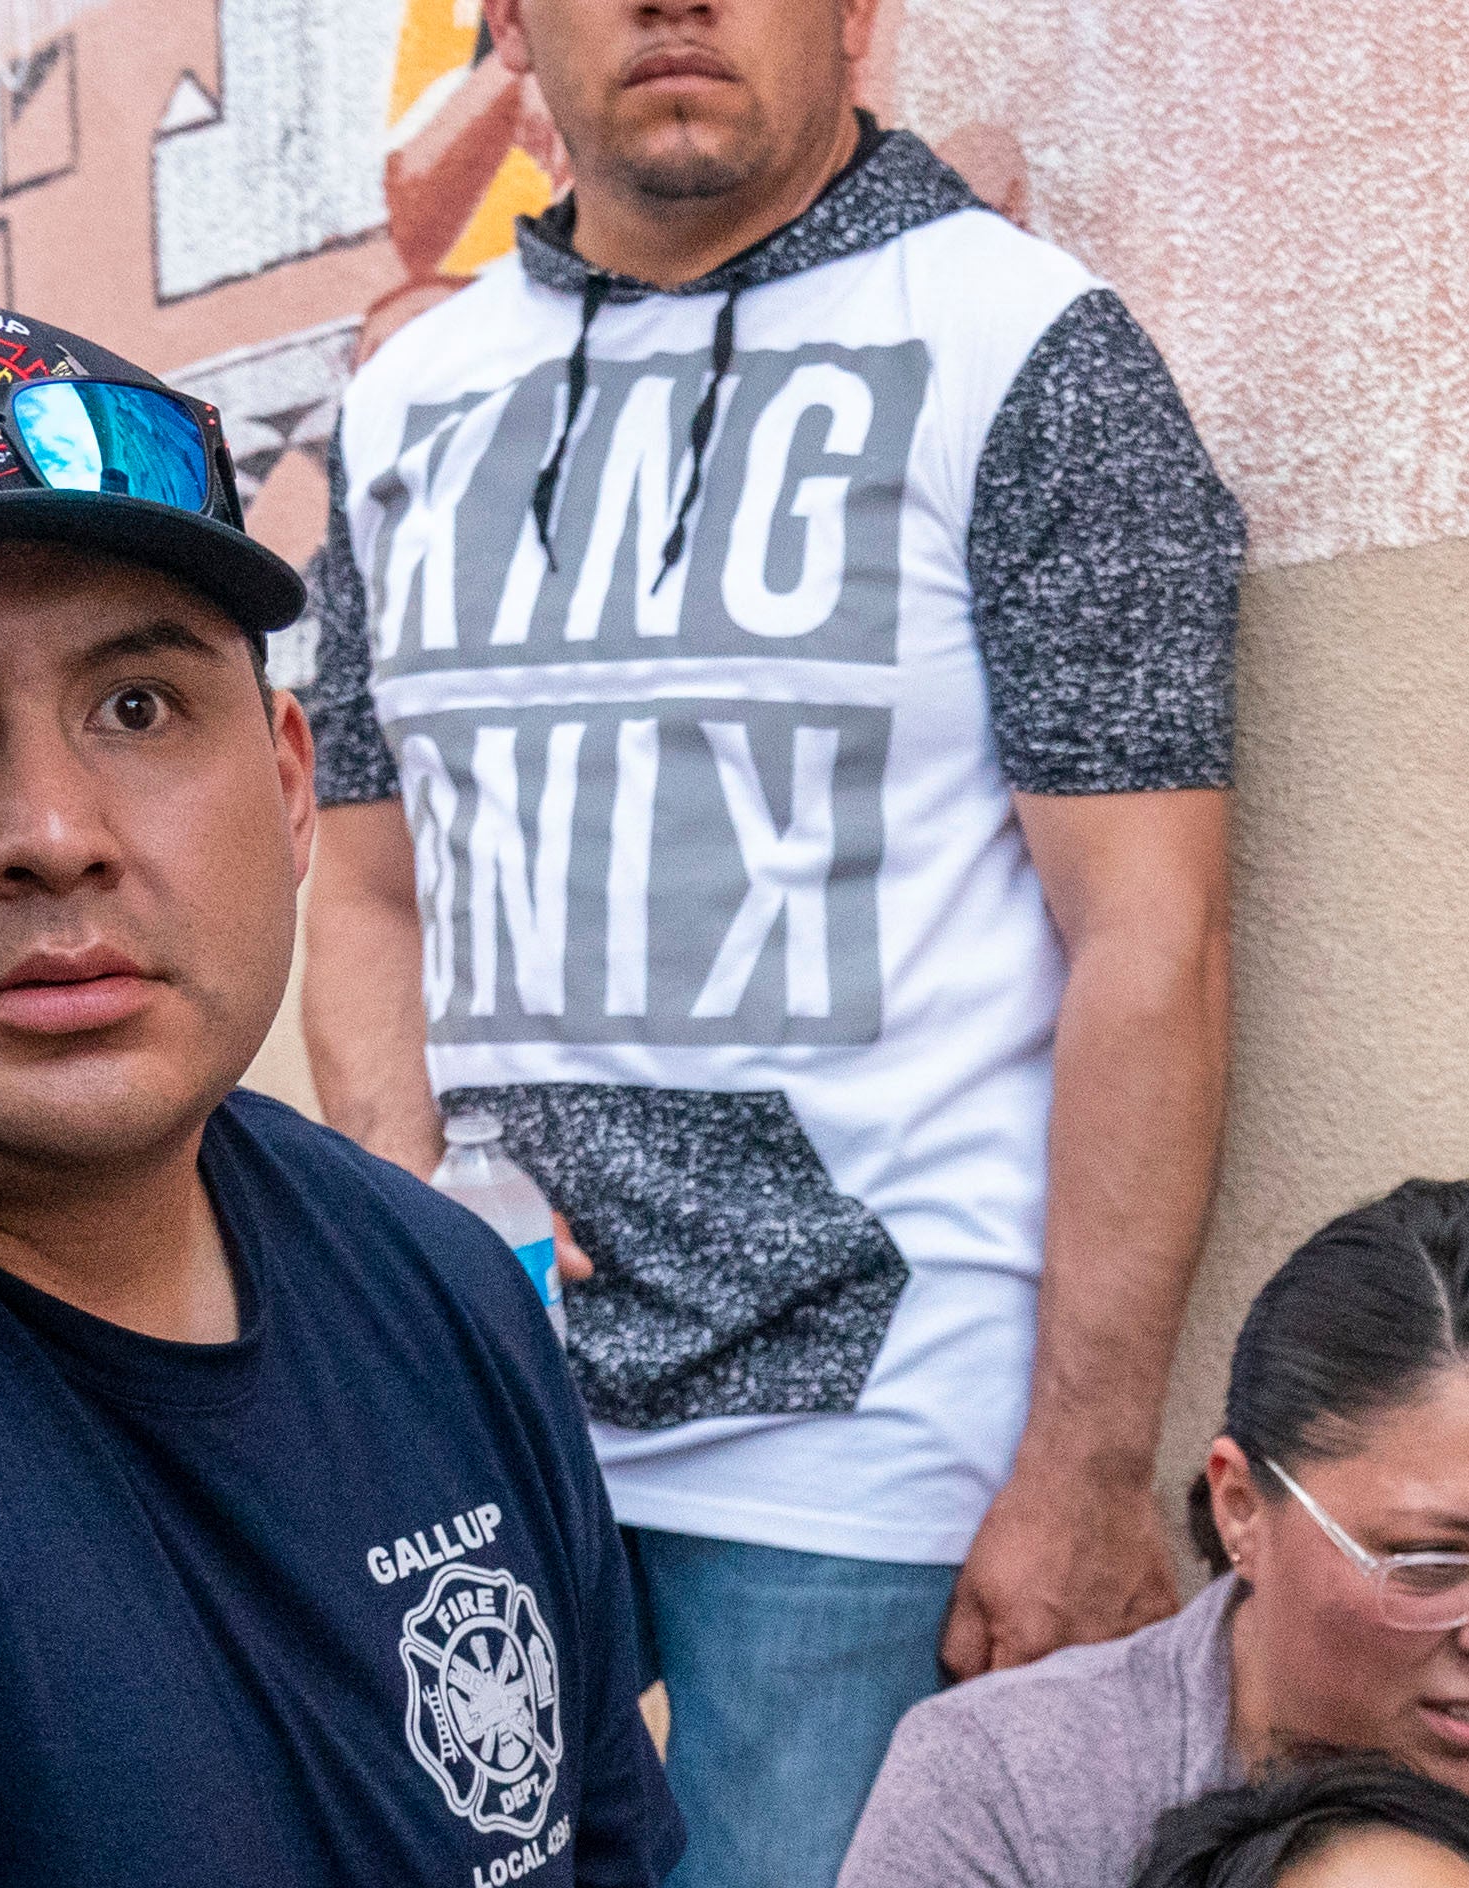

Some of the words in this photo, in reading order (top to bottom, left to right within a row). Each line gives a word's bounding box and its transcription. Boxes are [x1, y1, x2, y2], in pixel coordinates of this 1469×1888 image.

[379, 362, 874, 661] KING
[367, 1503, 503, 1585] GALLUP
[435, 1588, 497, 1634] FIRE
